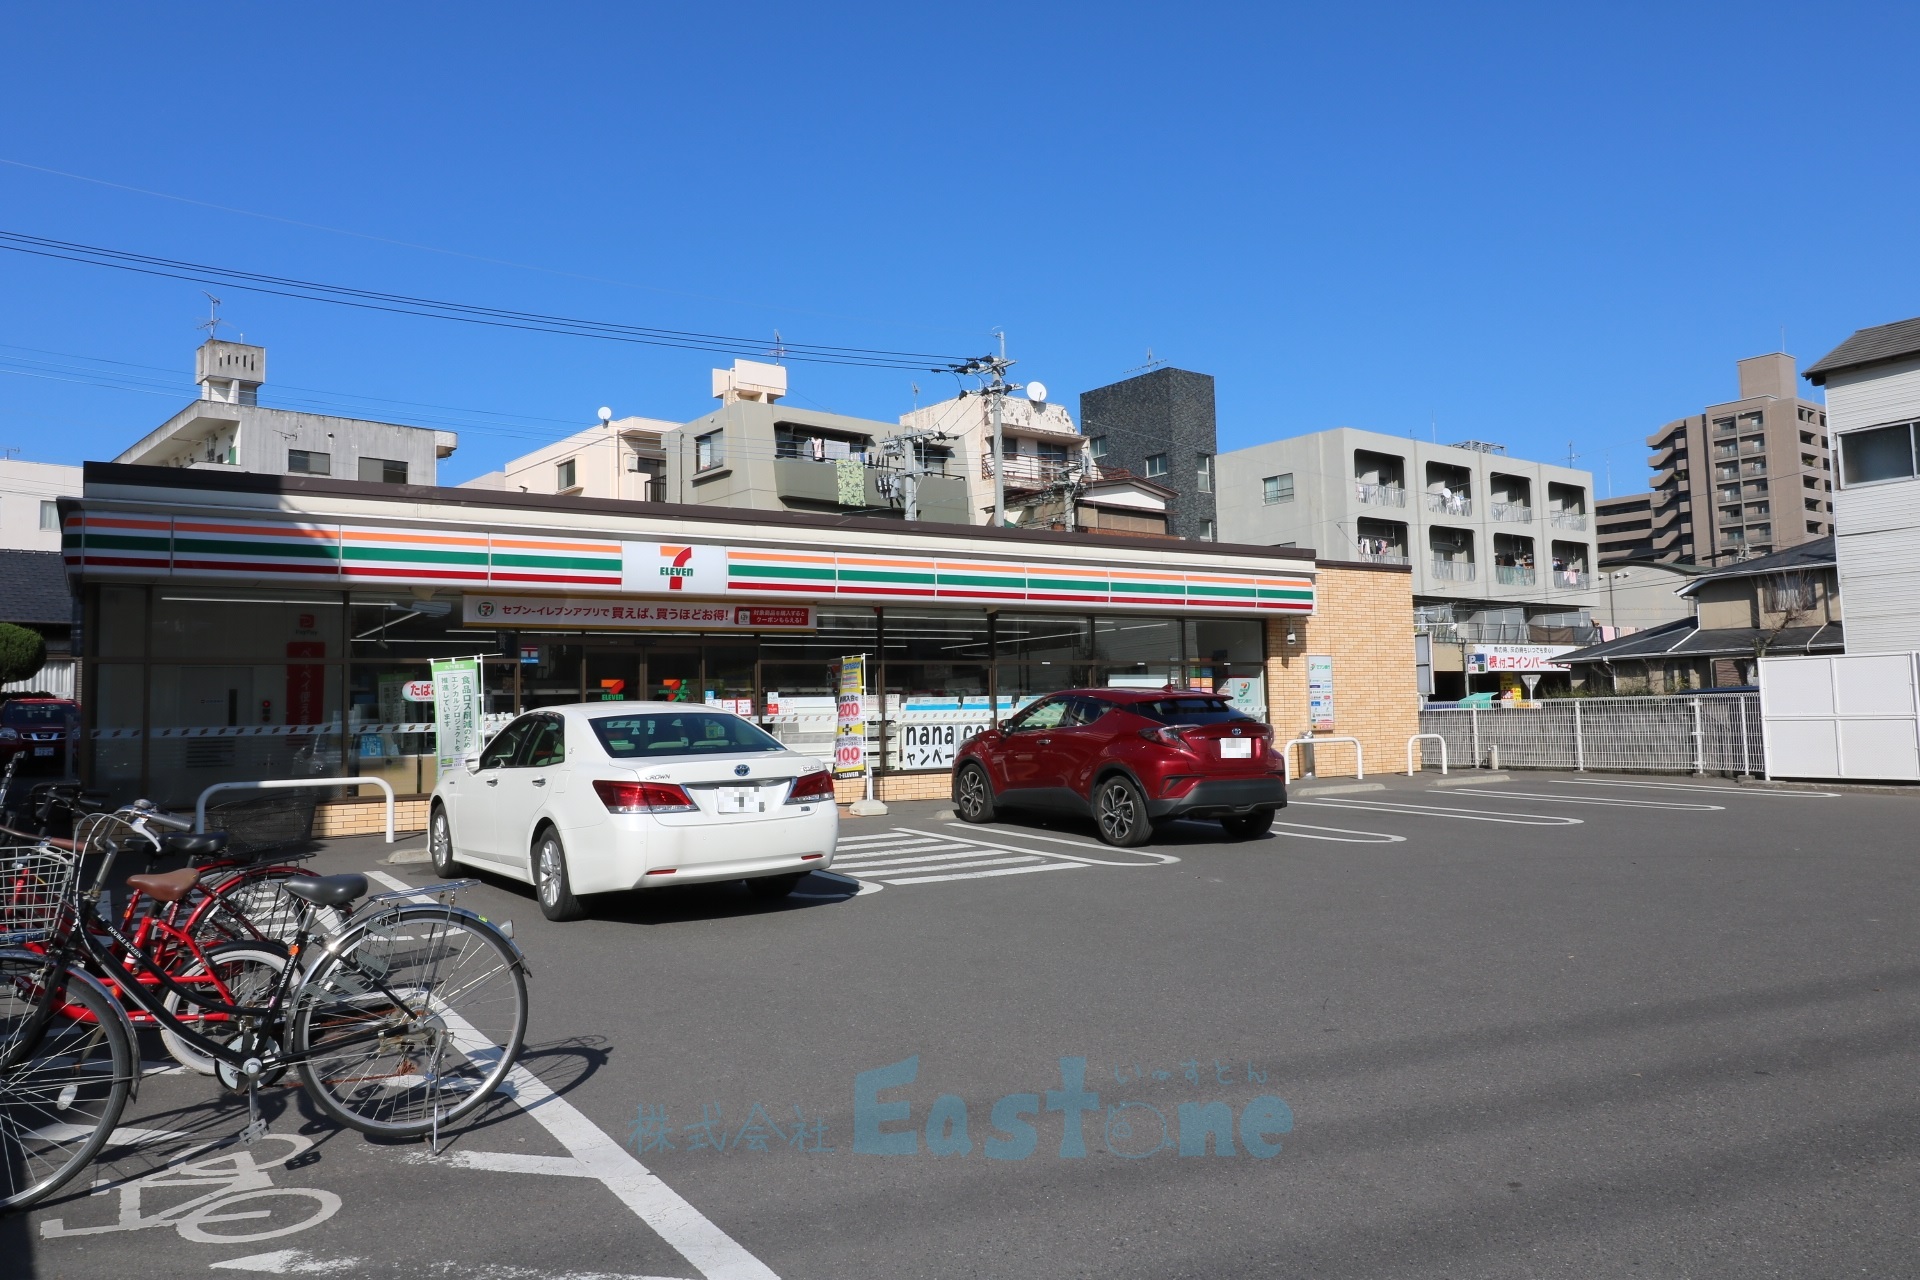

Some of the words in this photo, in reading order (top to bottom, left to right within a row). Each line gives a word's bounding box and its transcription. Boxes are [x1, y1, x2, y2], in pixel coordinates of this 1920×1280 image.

[441, 677, 452, 730] 推進しています。
[451, 676, 461, 752] エシカルプロジェクトを
[461, 675, 473, 749] 食品ロス削減のため
[838, 702, 860, 718] 200
[837, 746, 860, 762] 100
[107, 925, 126, 944] DOUBLE
